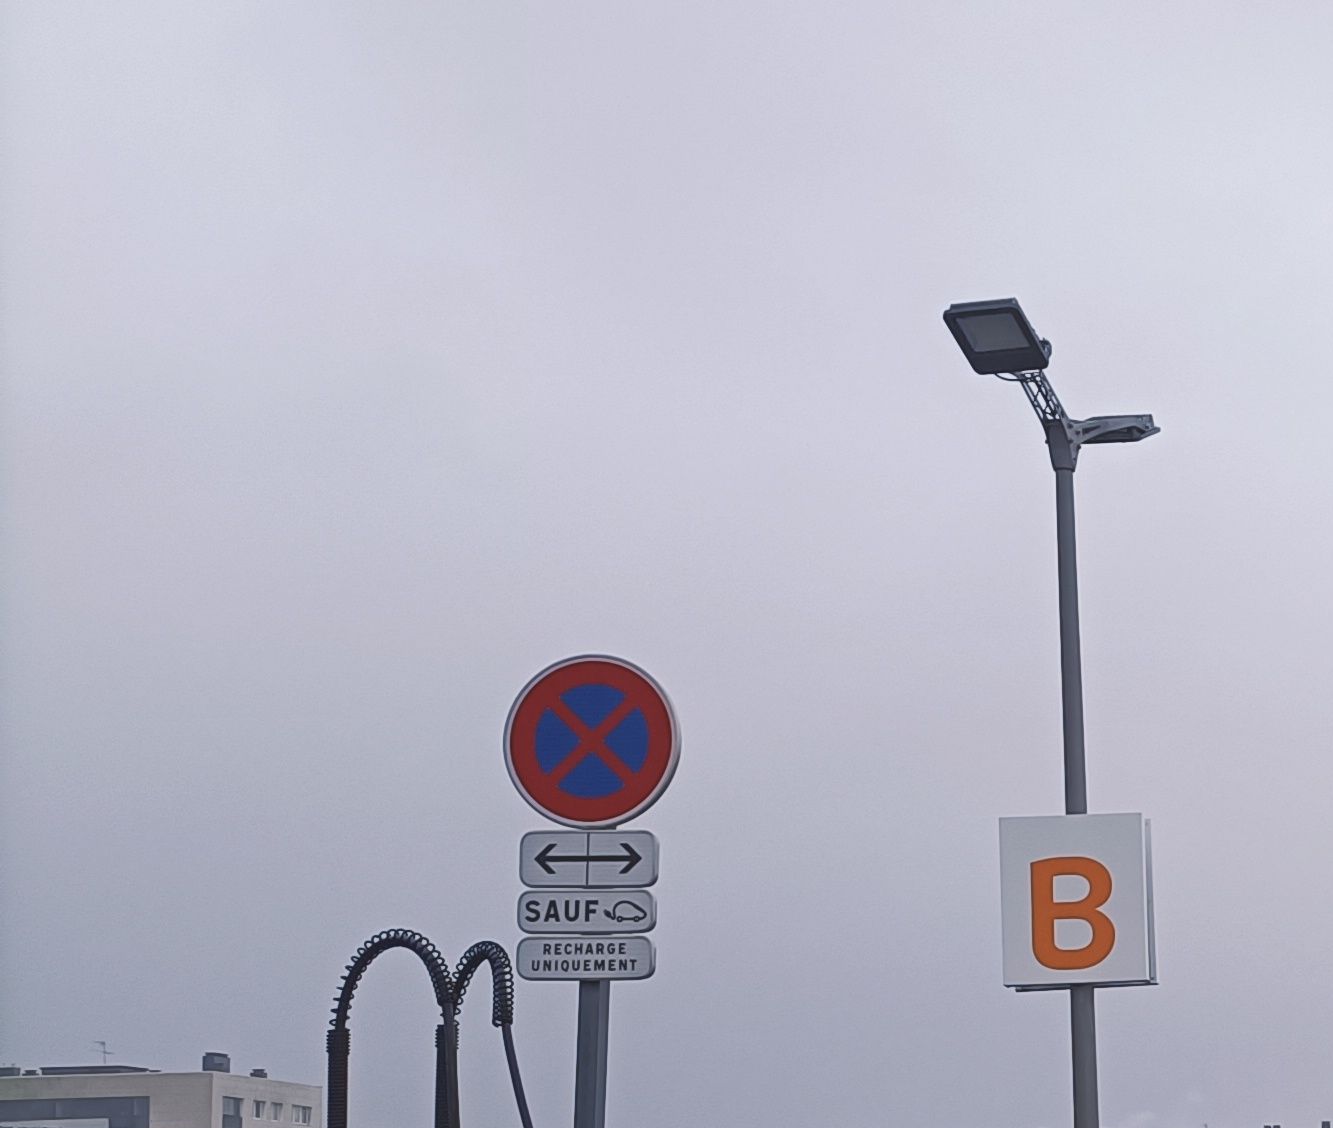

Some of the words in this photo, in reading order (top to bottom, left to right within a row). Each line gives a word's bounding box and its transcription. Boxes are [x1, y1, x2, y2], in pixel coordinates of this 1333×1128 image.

[525, 899, 600, 923] SAUF
[1030, 856, 1116, 970] B
[542, 942, 627, 955] RECHARGE
[531, 958, 638, 972] UNIQUEMENT
